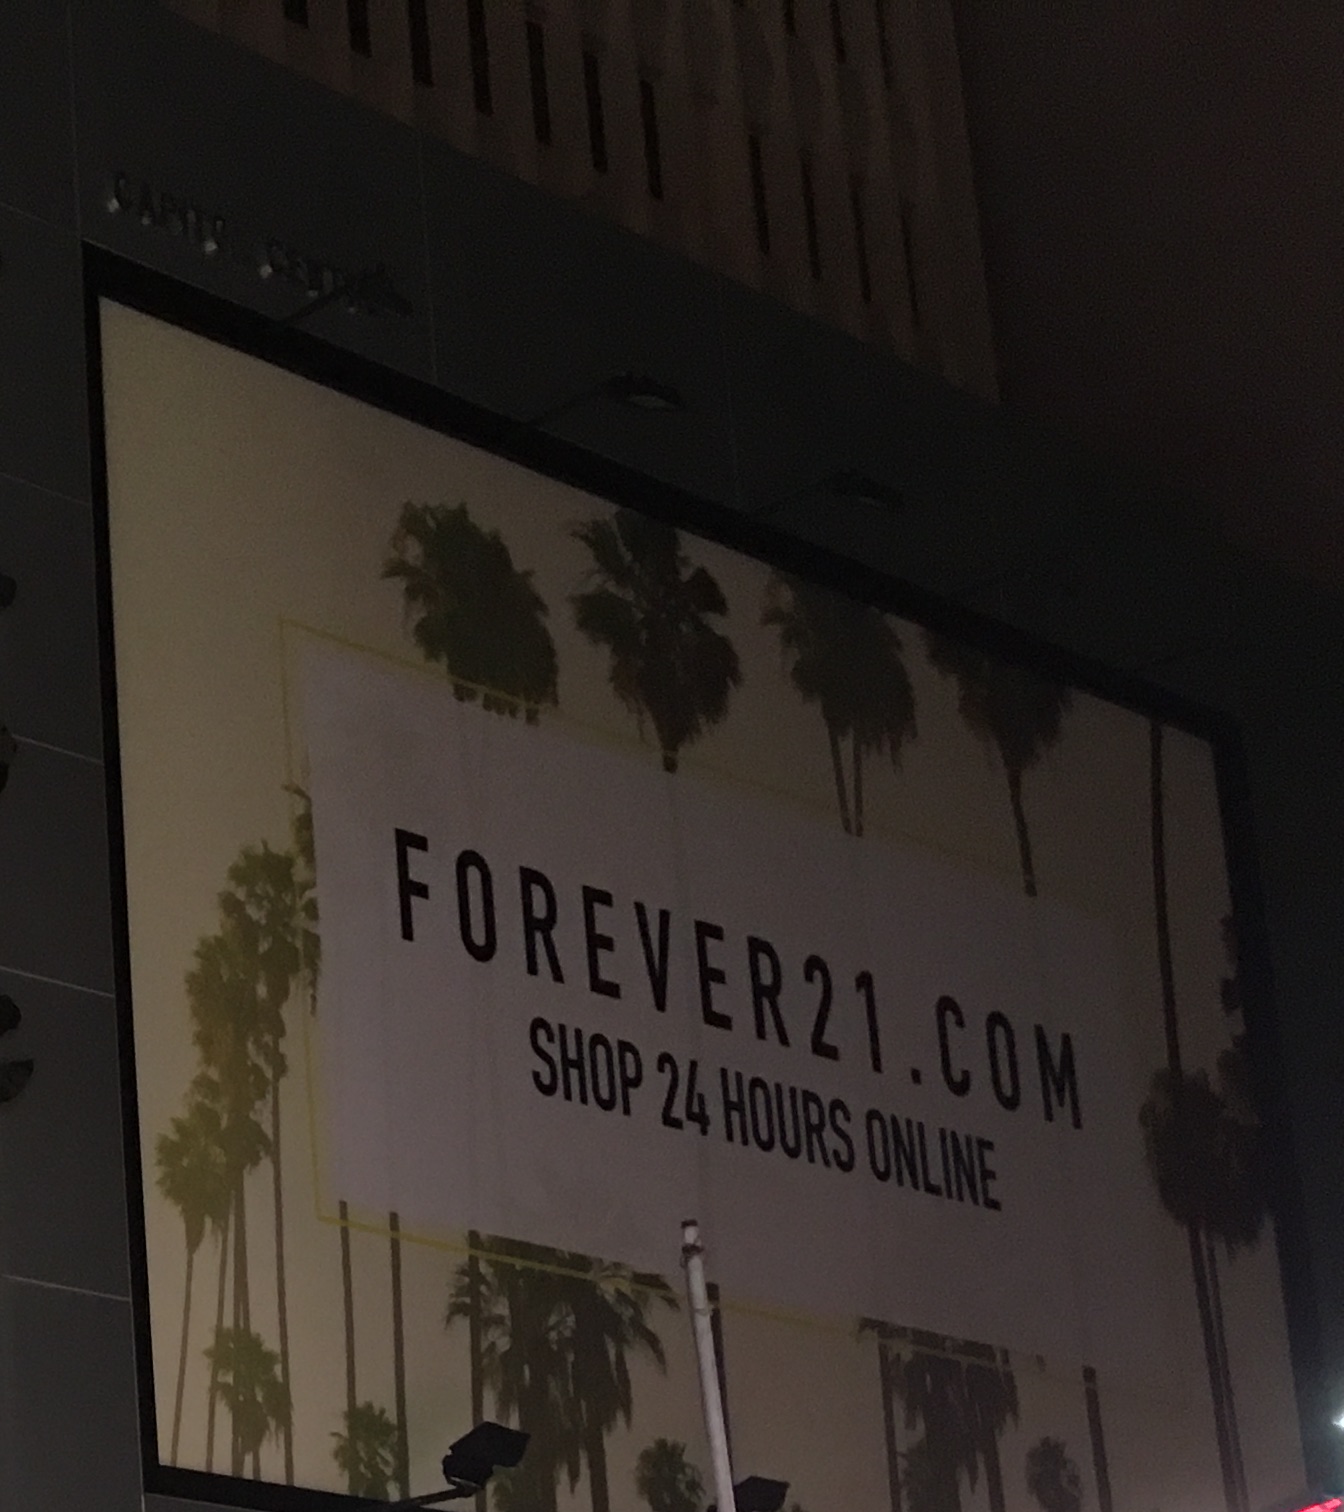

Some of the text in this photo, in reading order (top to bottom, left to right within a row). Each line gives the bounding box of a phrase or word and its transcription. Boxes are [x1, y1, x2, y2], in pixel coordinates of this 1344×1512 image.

[394, 827, 1083, 1130] FOREVER21.COM
[529, 1016, 1003, 1212] SHOP 24 HOURS ONLINE
